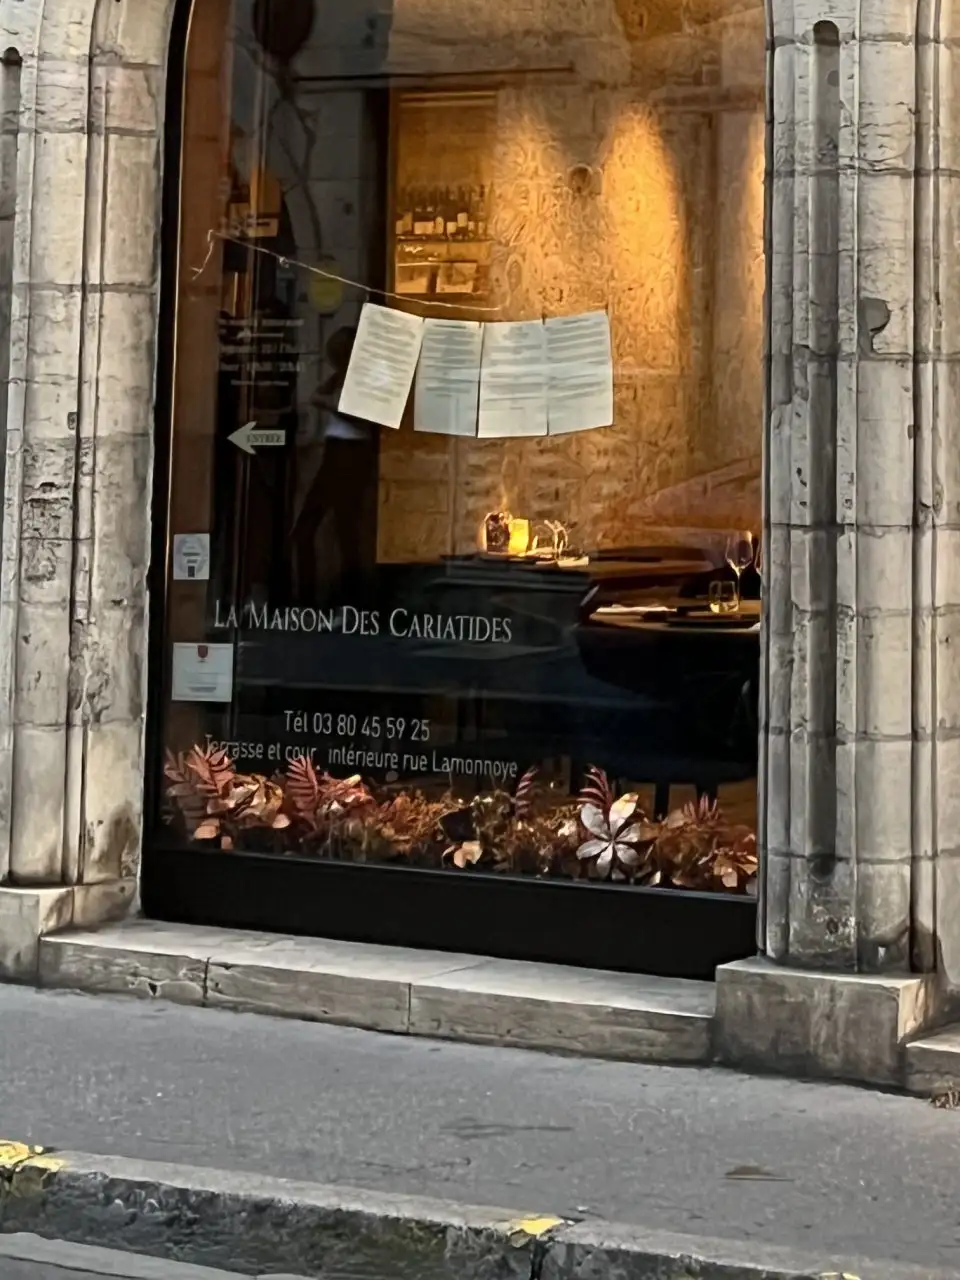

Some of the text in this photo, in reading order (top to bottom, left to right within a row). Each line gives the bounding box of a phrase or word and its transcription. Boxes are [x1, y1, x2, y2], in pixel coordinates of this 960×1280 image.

[213, 599, 513, 643] LA MAISON DES CARIATIDES
[284, 709, 431, 742] Tél 03 80 45 59 25
[403, 753, 428, 771] rue
[432, 749, 518, 784] Lamonnoye
